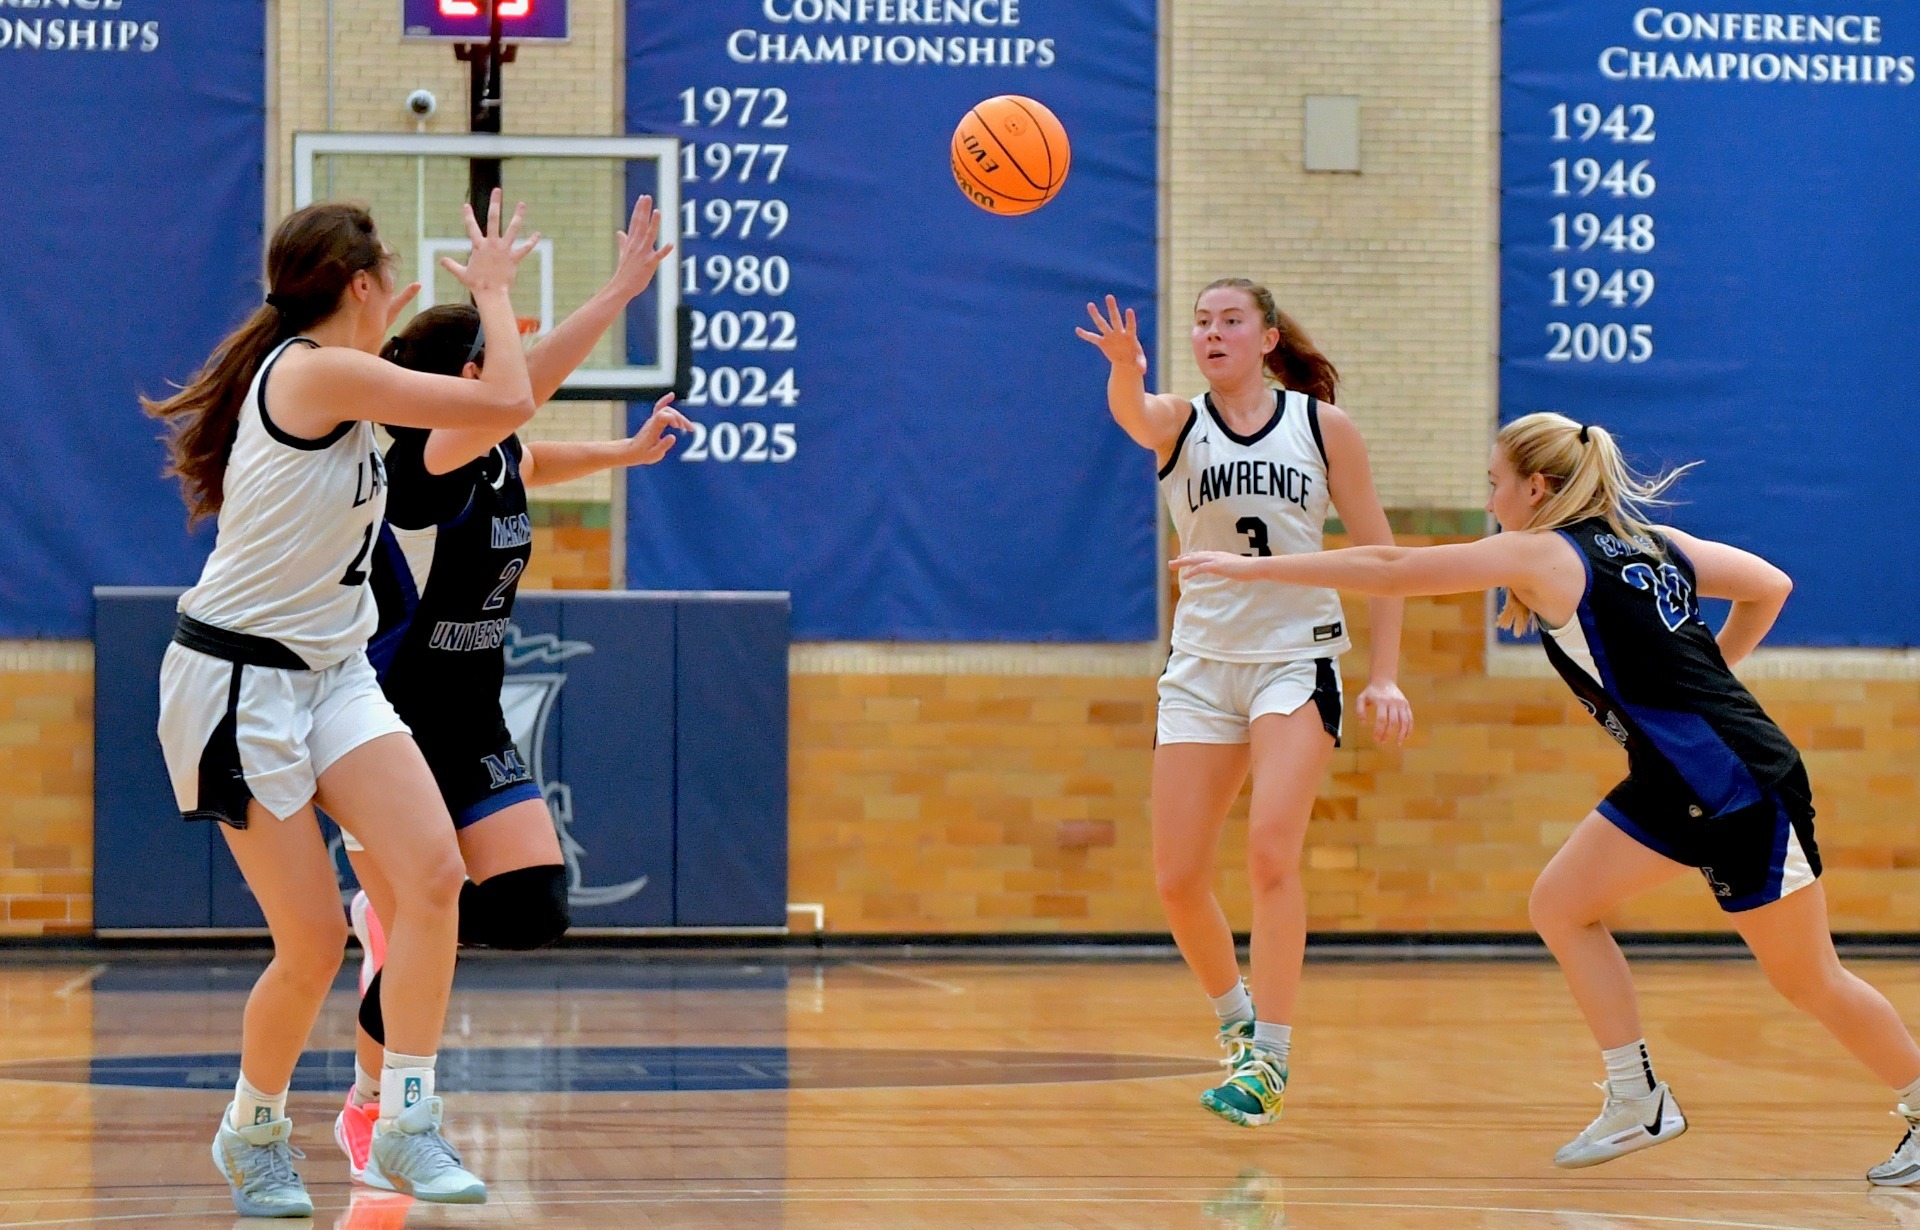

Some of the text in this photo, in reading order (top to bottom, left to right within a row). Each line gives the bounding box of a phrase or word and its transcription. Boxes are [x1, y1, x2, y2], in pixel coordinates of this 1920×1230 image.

[762, 0, 1021, 25] CONFERENCE
[1633, 7, 1882, 43] CONFERENCE
[726, 29, 1056, 67] CHAMPIONSHIPS
[1598, 46, 1915, 84] CHAMPIONSHIPS
[679, 86, 789, 128] 1972
[1548, 102, 1657, 143] 1942
[681, 142, 789, 184] 1977
[1548, 157, 1657, 199] 1946
[681, 198, 789, 240] 1979
[1547, 211, 1656, 254] 1948
[681, 254, 791, 297] 1980
[1547, 267, 1656, 309] 1949
[691, 309, 798, 351] 2022
[1544, 321, 1654, 364] 2005
[679, 365, 800, 407] 2024
[679, 421, 798, 463] 2025
[1187, 460, 1313, 513] LAWRENCE
[1235, 516, 1272, 557] 3
[482, 557, 524, 611] 2
